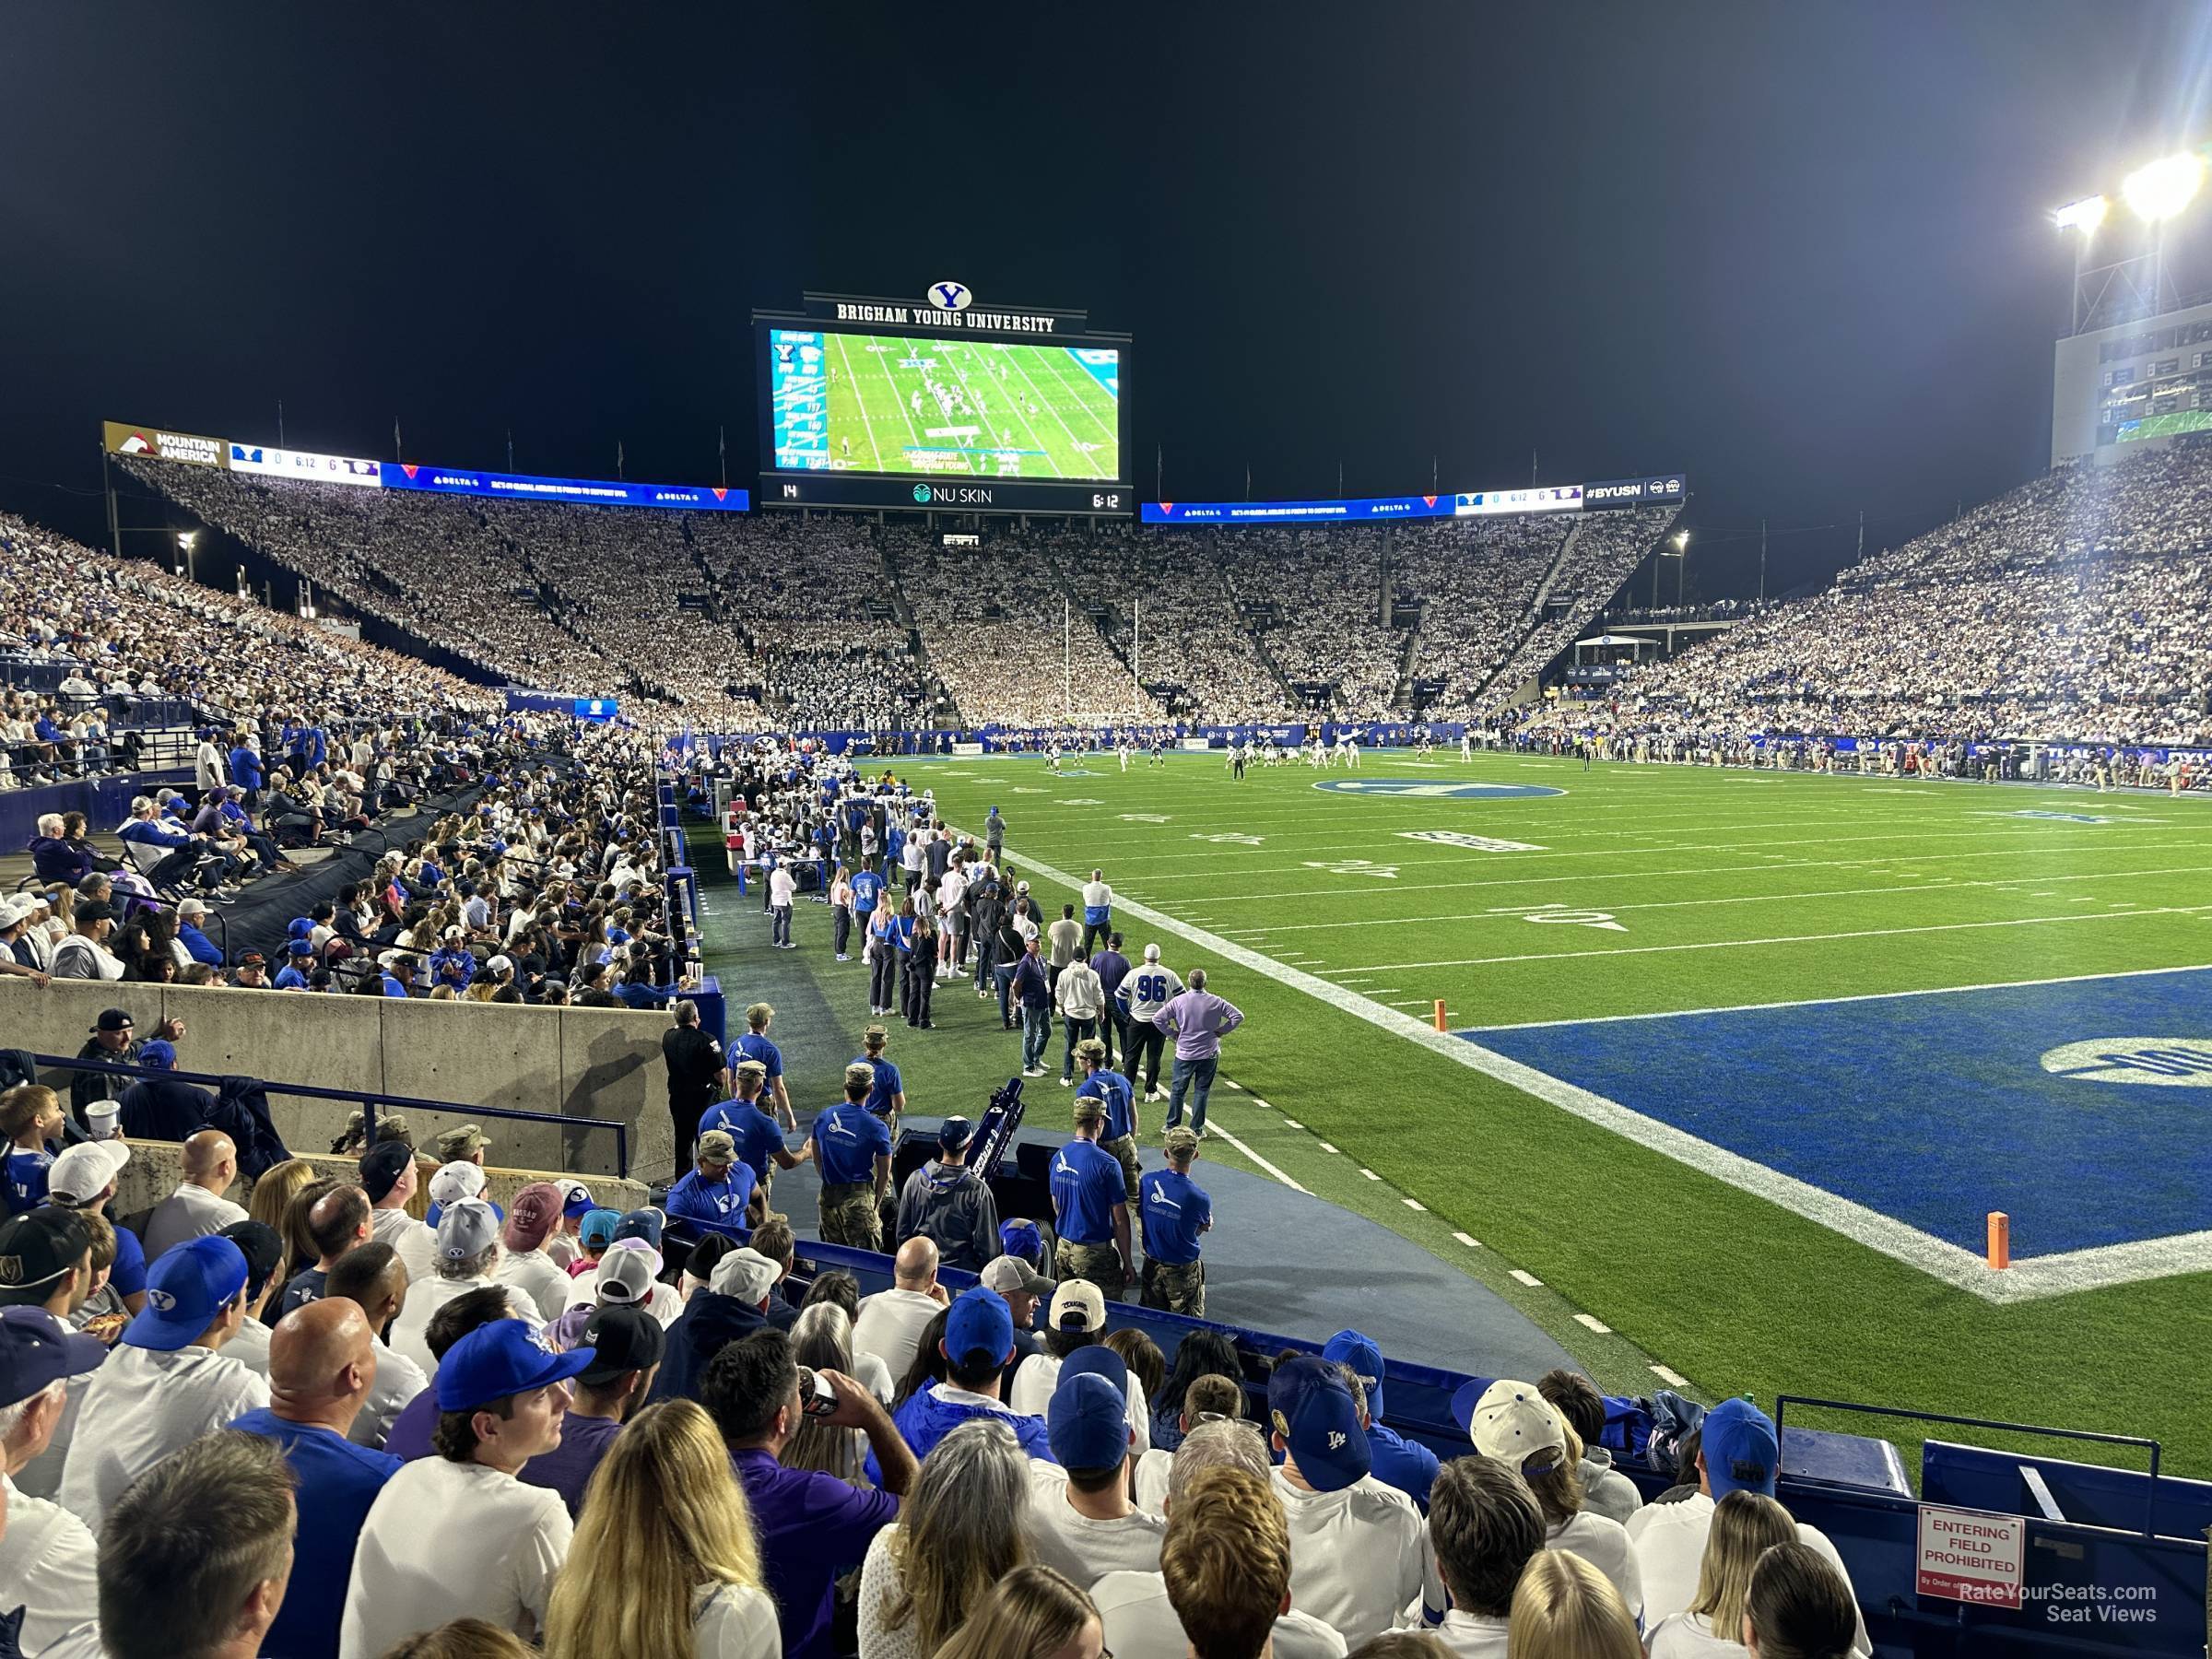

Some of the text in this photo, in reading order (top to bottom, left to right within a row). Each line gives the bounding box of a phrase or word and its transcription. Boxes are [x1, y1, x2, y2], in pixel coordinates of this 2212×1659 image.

[837, 303, 1054, 333] BRIGHAM YOUNG UNIVERSITY
[156, 433, 220, 453] MOUNTAIN
[160, 446, 218, 465] AMERICA
[296, 457, 315, 468] 6:12
[442, 477, 471, 487] DELTA
[665, 493, 690, 502] DELTA
[783, 485, 797, 498] 14
[934, 488, 993, 504] NU SKIN
[1586, 485, 1641, 499] #BYUSN
[1093, 495, 1119, 508] 6:12
[1310, 730, 1320, 738] 14
[1137, 975, 1167, 1003] 96
[1327, 1430, 1346, 1450] LA
[1933, 1519, 2010, 1541] ENTERING
[1949, 1537, 1992, 1553] FIELD
[1924, 1549, 2016, 1572] PROHIBITED
[1921, 1576, 1930, 1585] By
[1932, 1578, 1951, 1588] Order
